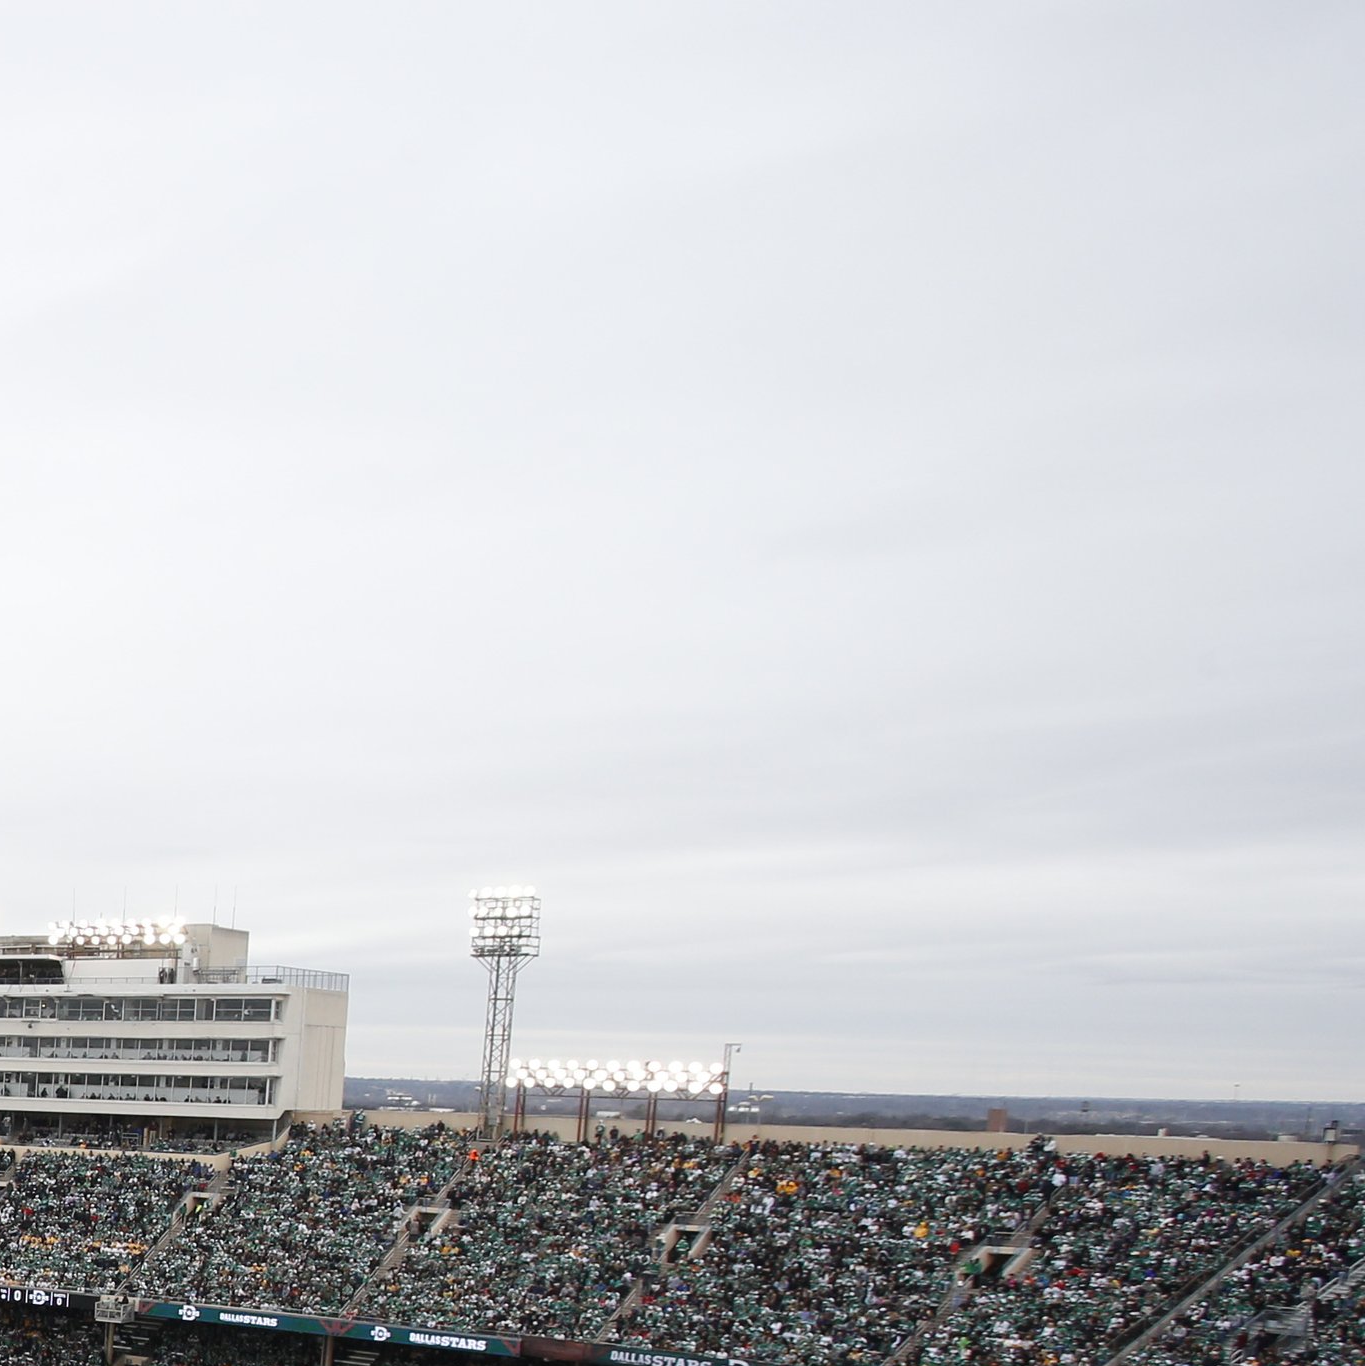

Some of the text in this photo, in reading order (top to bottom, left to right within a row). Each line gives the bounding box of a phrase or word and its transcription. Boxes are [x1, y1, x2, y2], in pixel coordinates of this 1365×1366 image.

[14, 1289, 21, 1301] 0
[219, 1312, 278, 1328] DALLAS STARS
[409, 1331, 487, 1351] DALLAS STARS
[610, 1349, 653, 1366] DALLAS
